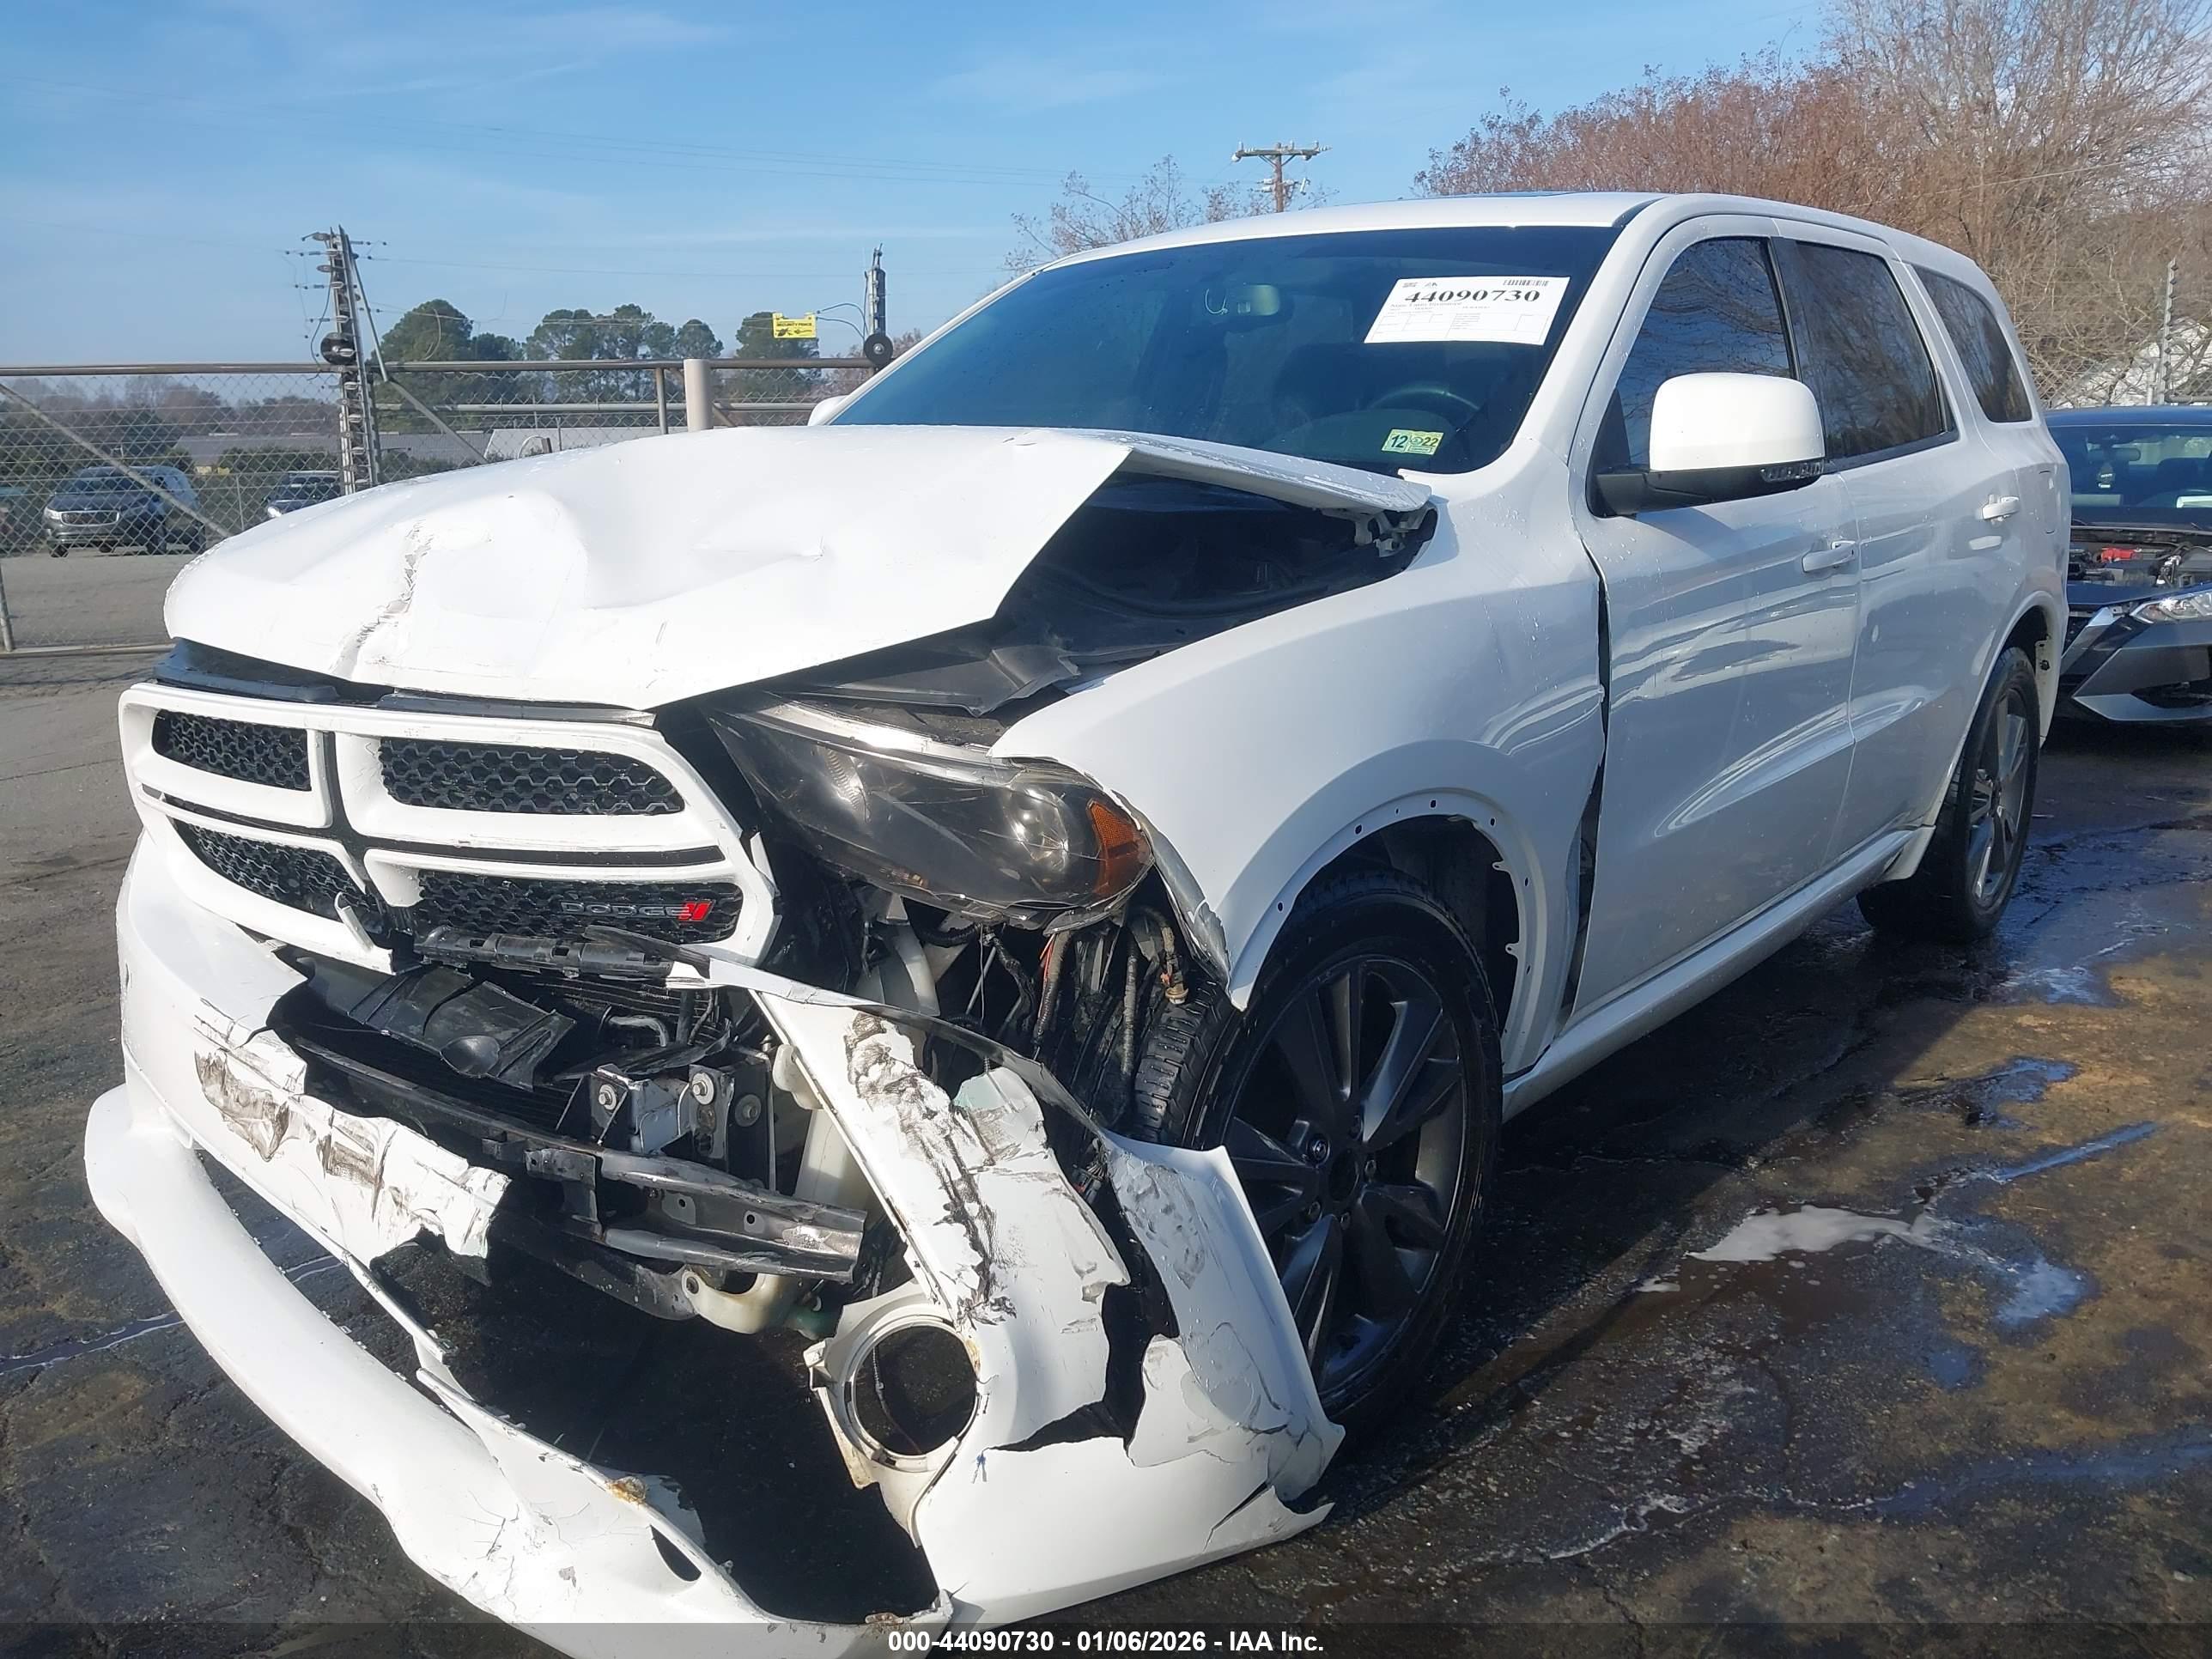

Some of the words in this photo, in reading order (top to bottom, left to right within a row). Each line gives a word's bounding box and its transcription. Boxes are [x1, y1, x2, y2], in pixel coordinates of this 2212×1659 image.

[1404, 289, 1540, 303] 44090730
[1390, 434, 1408, 448] 12
[1422, 436, 1439, 447] 22
[561, 902, 692, 917] DODGE
